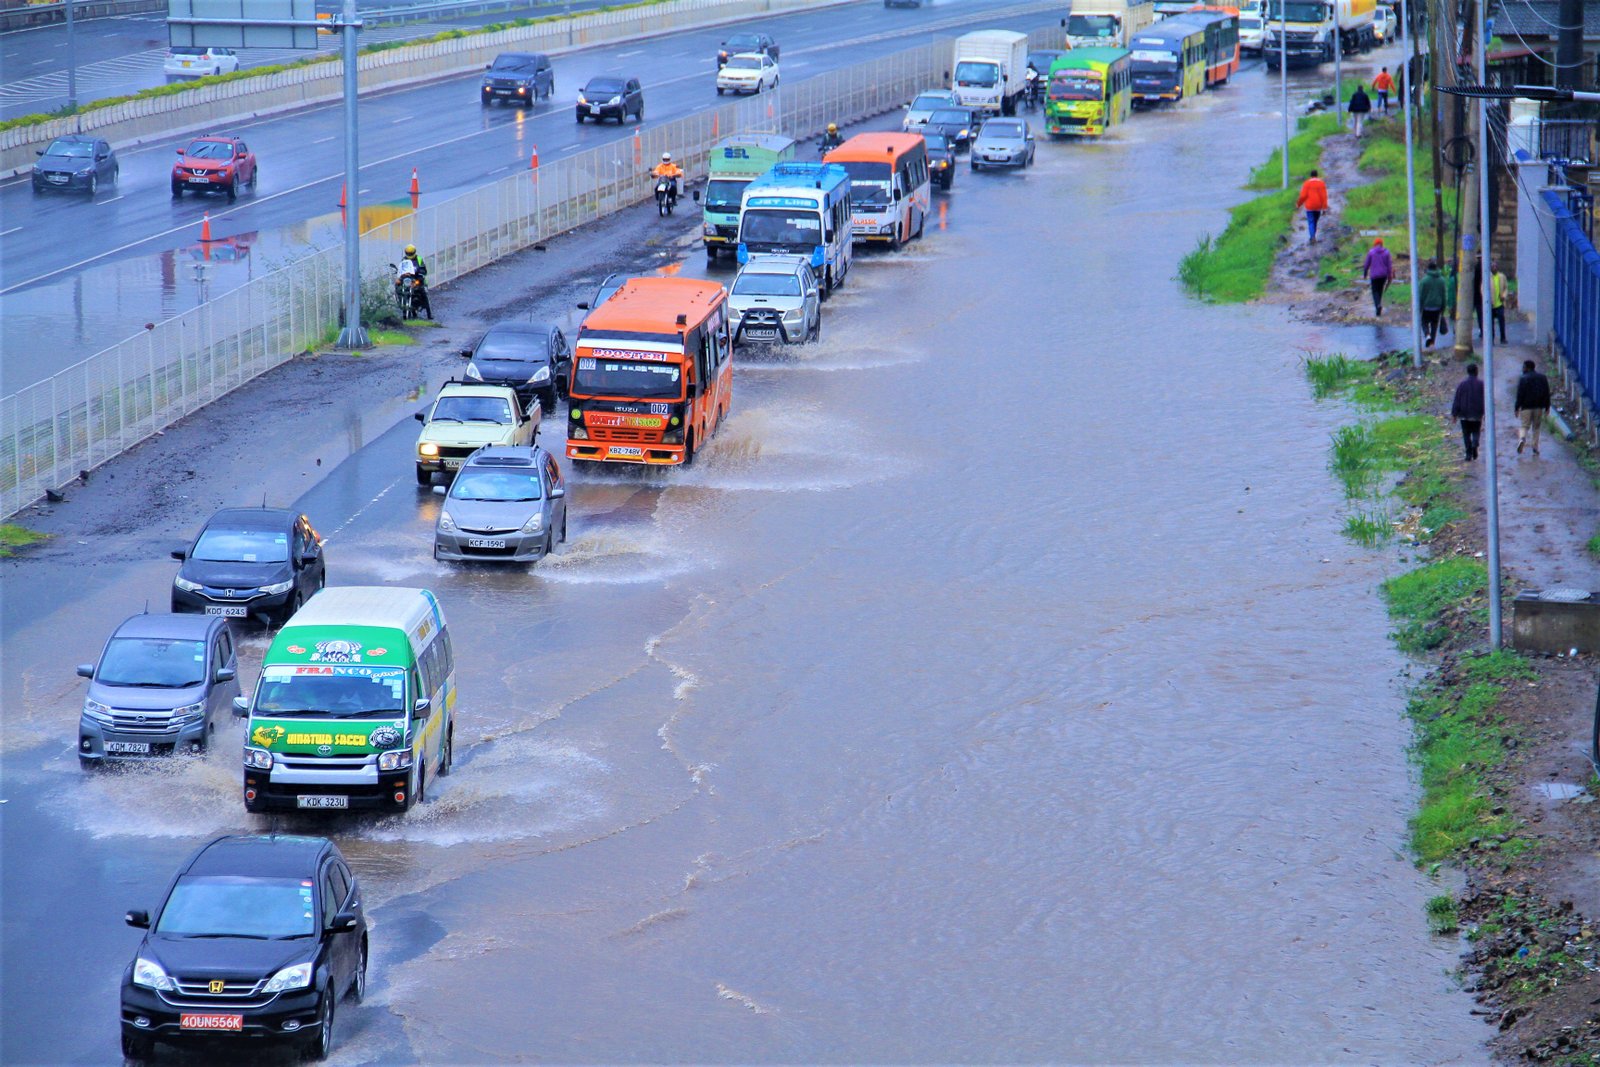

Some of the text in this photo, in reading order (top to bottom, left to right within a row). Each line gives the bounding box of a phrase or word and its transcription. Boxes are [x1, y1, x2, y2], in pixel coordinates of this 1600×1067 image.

[580, 358, 595, 369] 002
[650, 404, 667, 413] 002
[469, 539, 505, 548] KCF 159C
[225, 607, 245, 616] 624S
[295, 666, 373, 676] FRANCO
[334, 734, 366, 746] SACCO
[128, 743, 148, 753] 782V
[306, 797, 345, 807] KDK 323U
[181, 1016, 241, 1029] 40UN556K
